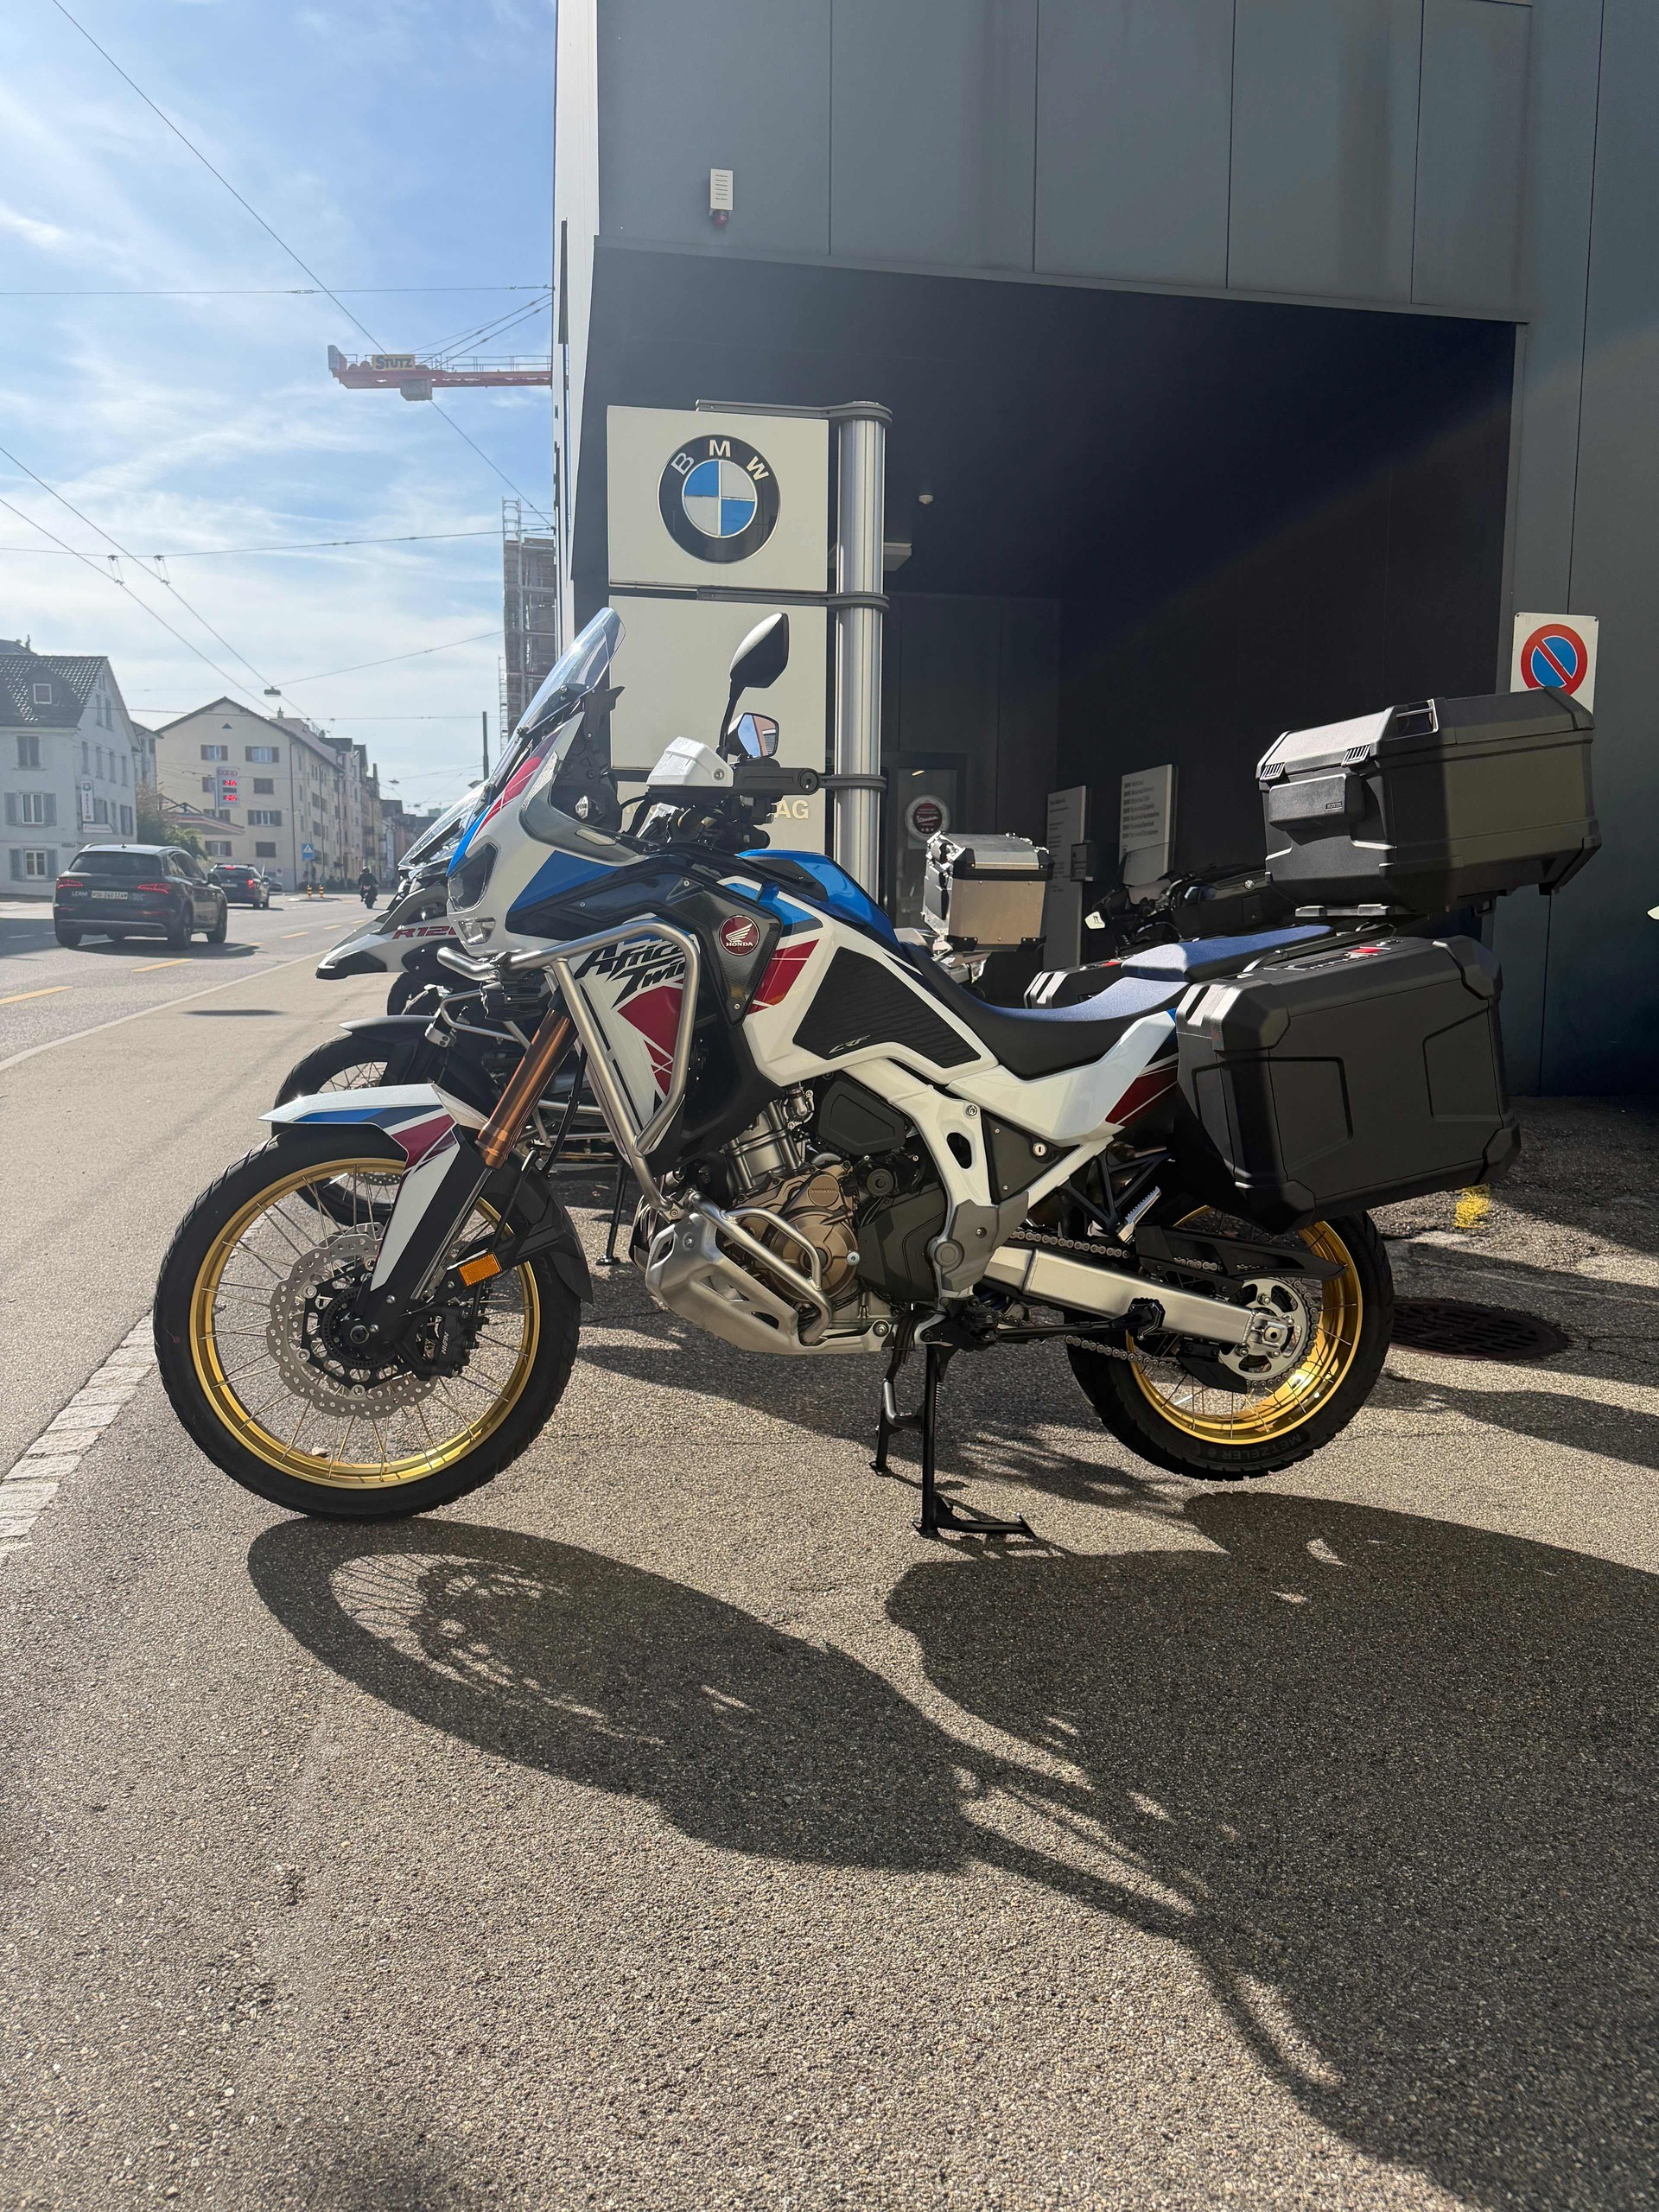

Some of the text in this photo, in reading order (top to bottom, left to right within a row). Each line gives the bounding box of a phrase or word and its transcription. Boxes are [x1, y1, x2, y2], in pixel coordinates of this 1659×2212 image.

[375, 354, 413, 370] STUTZ
[671, 439, 770, 480] BMW
[774, 800, 809, 819] AG
[1221, 1433, 1302, 1460] METZELER
